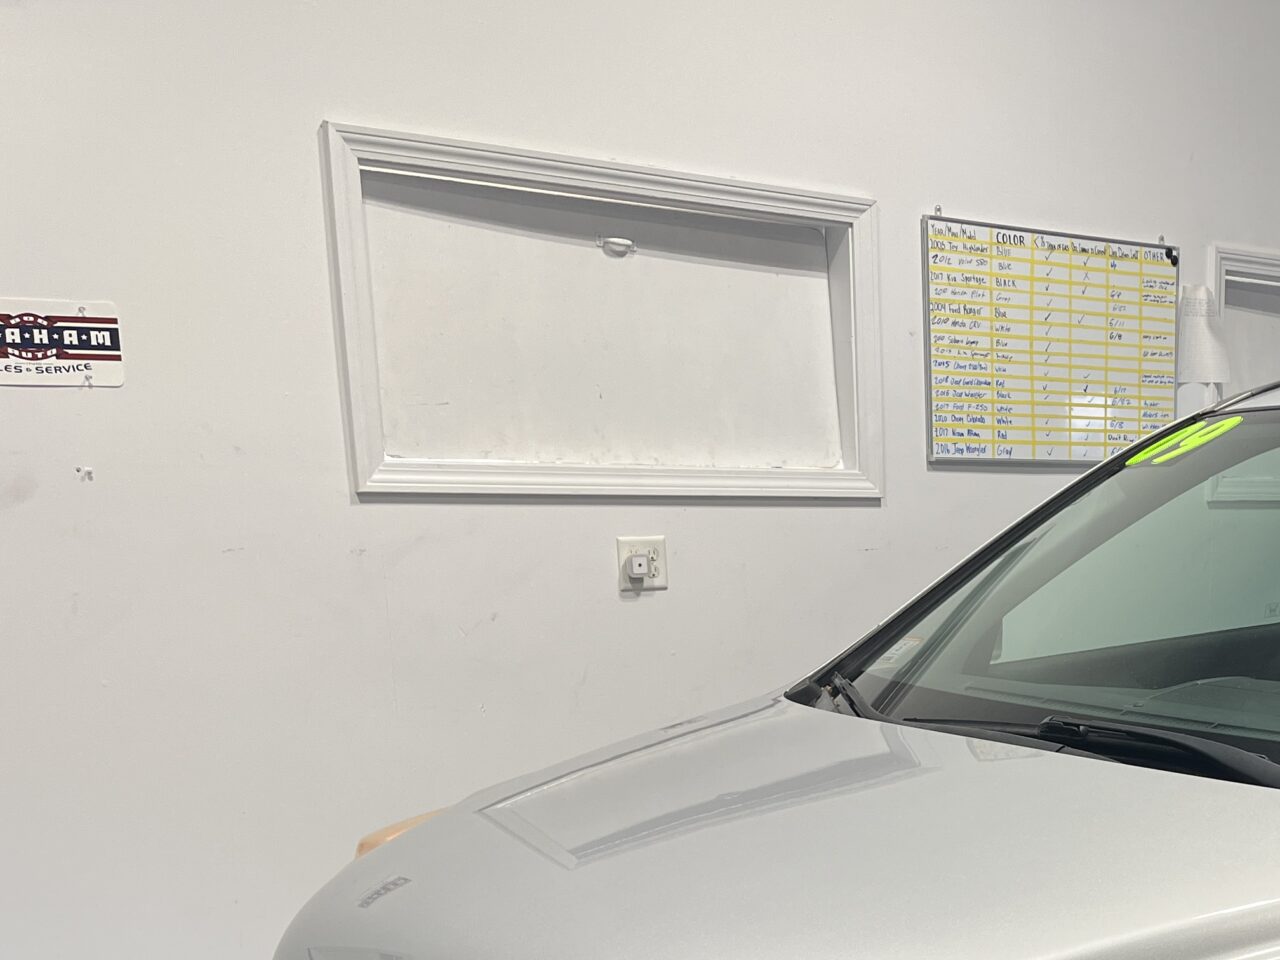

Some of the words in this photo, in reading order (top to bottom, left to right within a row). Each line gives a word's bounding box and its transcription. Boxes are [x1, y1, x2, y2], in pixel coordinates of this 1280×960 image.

[996, 232, 1026, 246] COLOR
[932, 254, 952, 265] 2012
[1144, 250, 1165, 262] OTHER
[947, 273, 956, 282] Kia
[961, 274, 987, 284] Sportage
[996, 278, 1016, 288] BLACK
[0, 364, 23, 373] ES
[35, 363, 93, 374] SERVICE
